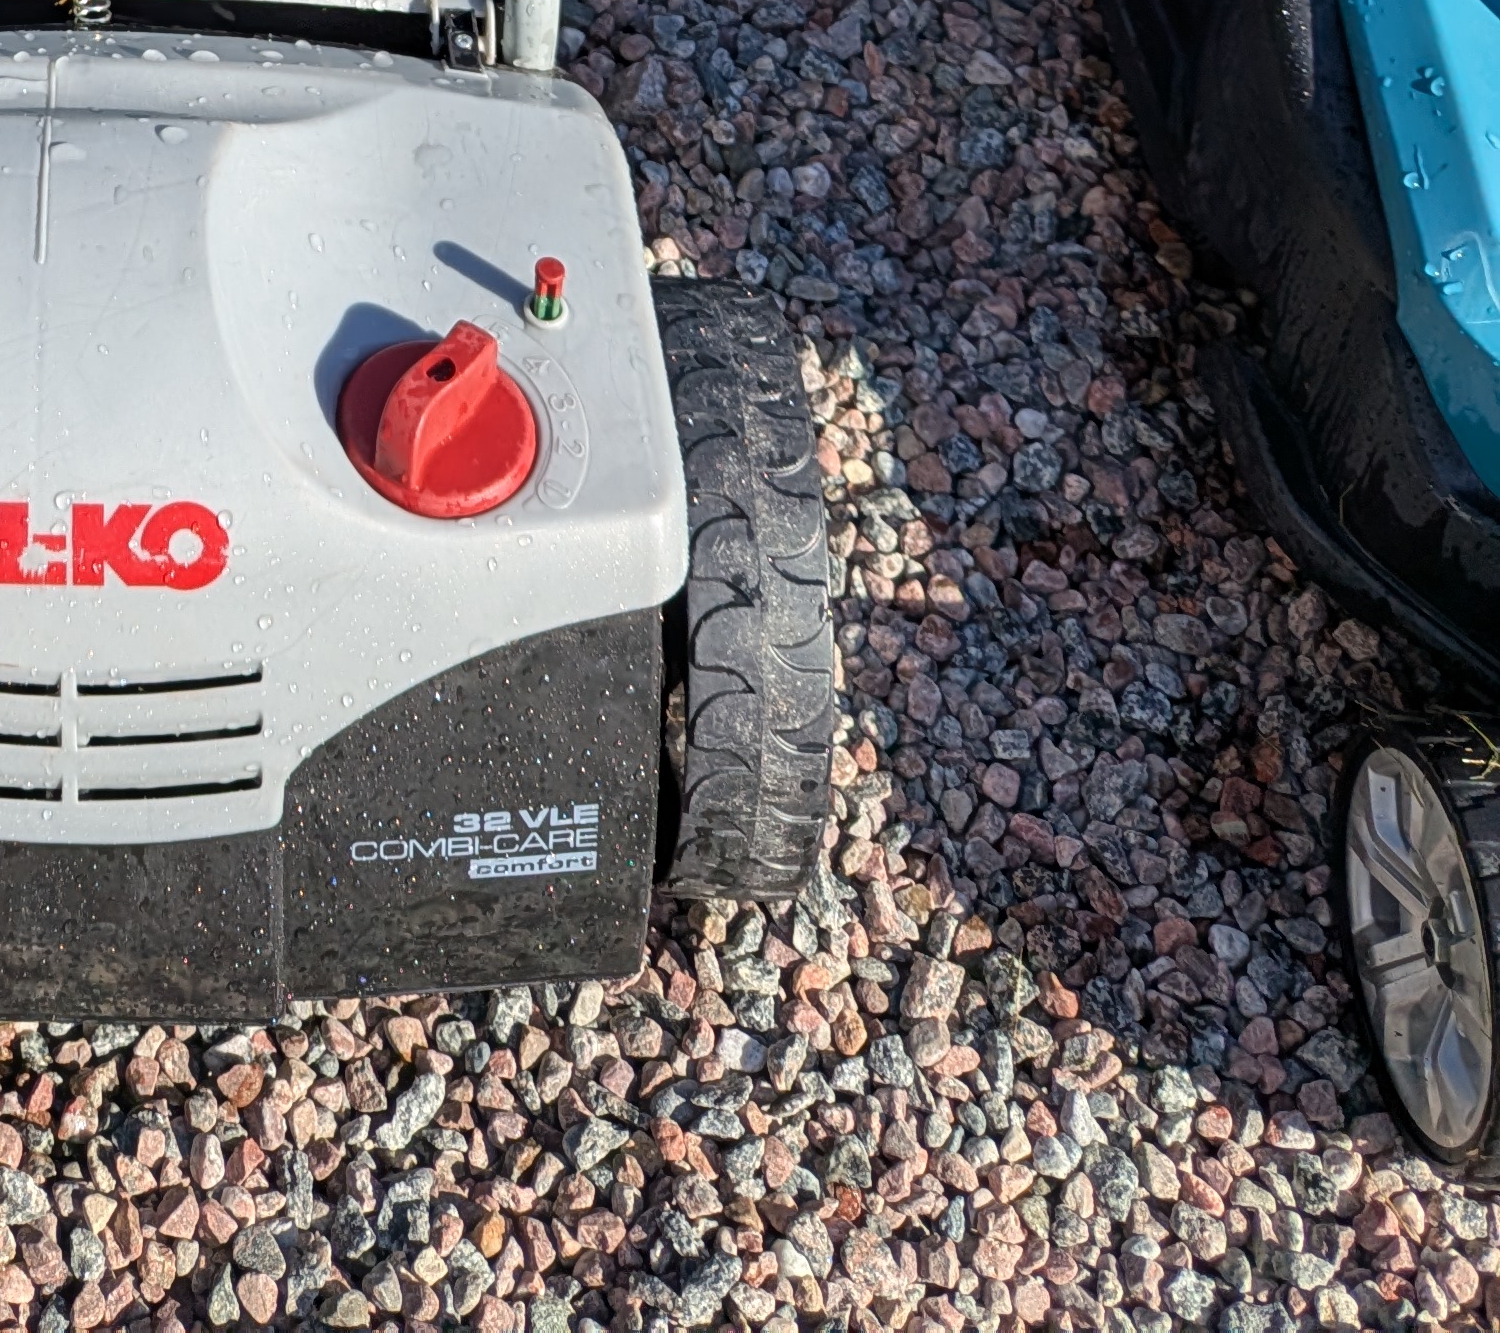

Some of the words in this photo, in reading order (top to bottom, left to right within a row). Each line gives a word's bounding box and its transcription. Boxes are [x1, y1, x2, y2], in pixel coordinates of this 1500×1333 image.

[522, 355, 552, 376] 4
[549, 393, 577, 413] 3
[554, 436, 585, 459] 2
[453, 811, 512, 834] 32
[519, 803, 600, 829] VLE
[351, 828, 599, 862] COMBI-CARE
[475, 855, 596, 876] comfort
